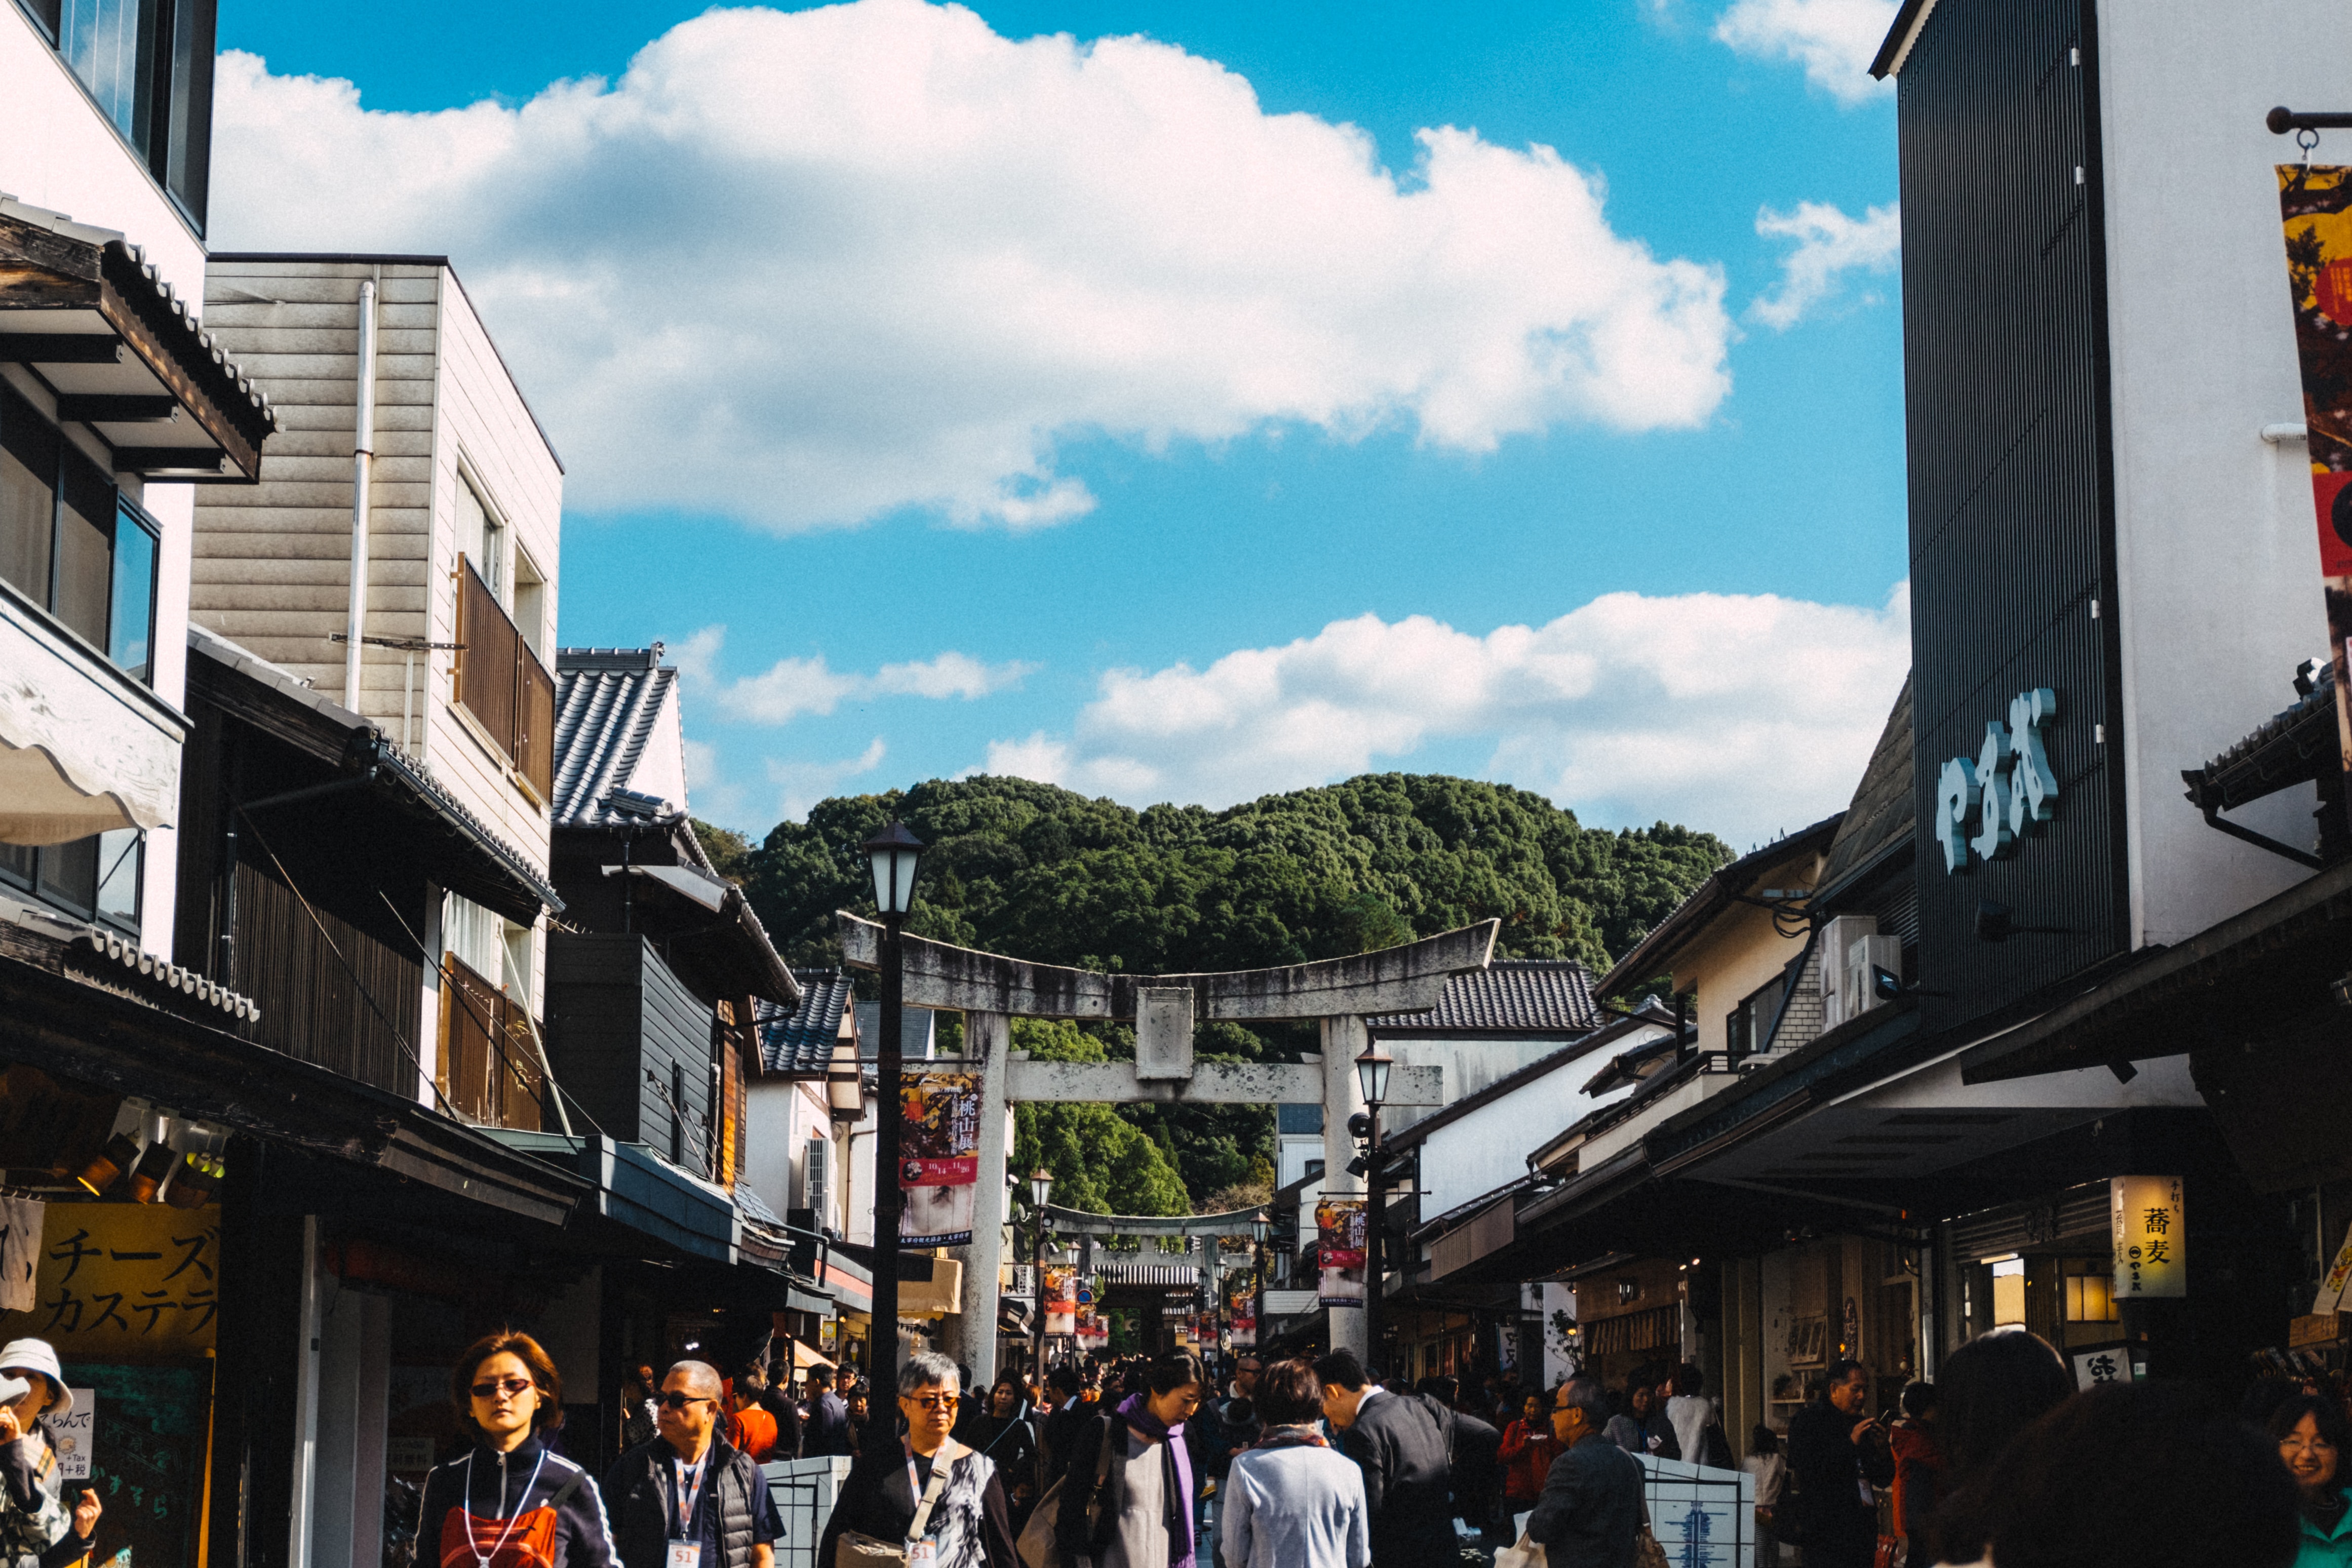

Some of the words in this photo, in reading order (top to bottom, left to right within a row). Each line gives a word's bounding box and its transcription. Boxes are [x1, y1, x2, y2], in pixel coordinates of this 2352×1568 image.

[49, 1226, 222, 1285] チーズ
[2143, 1207, 2171, 1264] 蕎麦
[42, 1287, 218, 1336] カステラ
[675, 1550, 692, 1563] 51
[913, 1547, 929, 1559] 51
